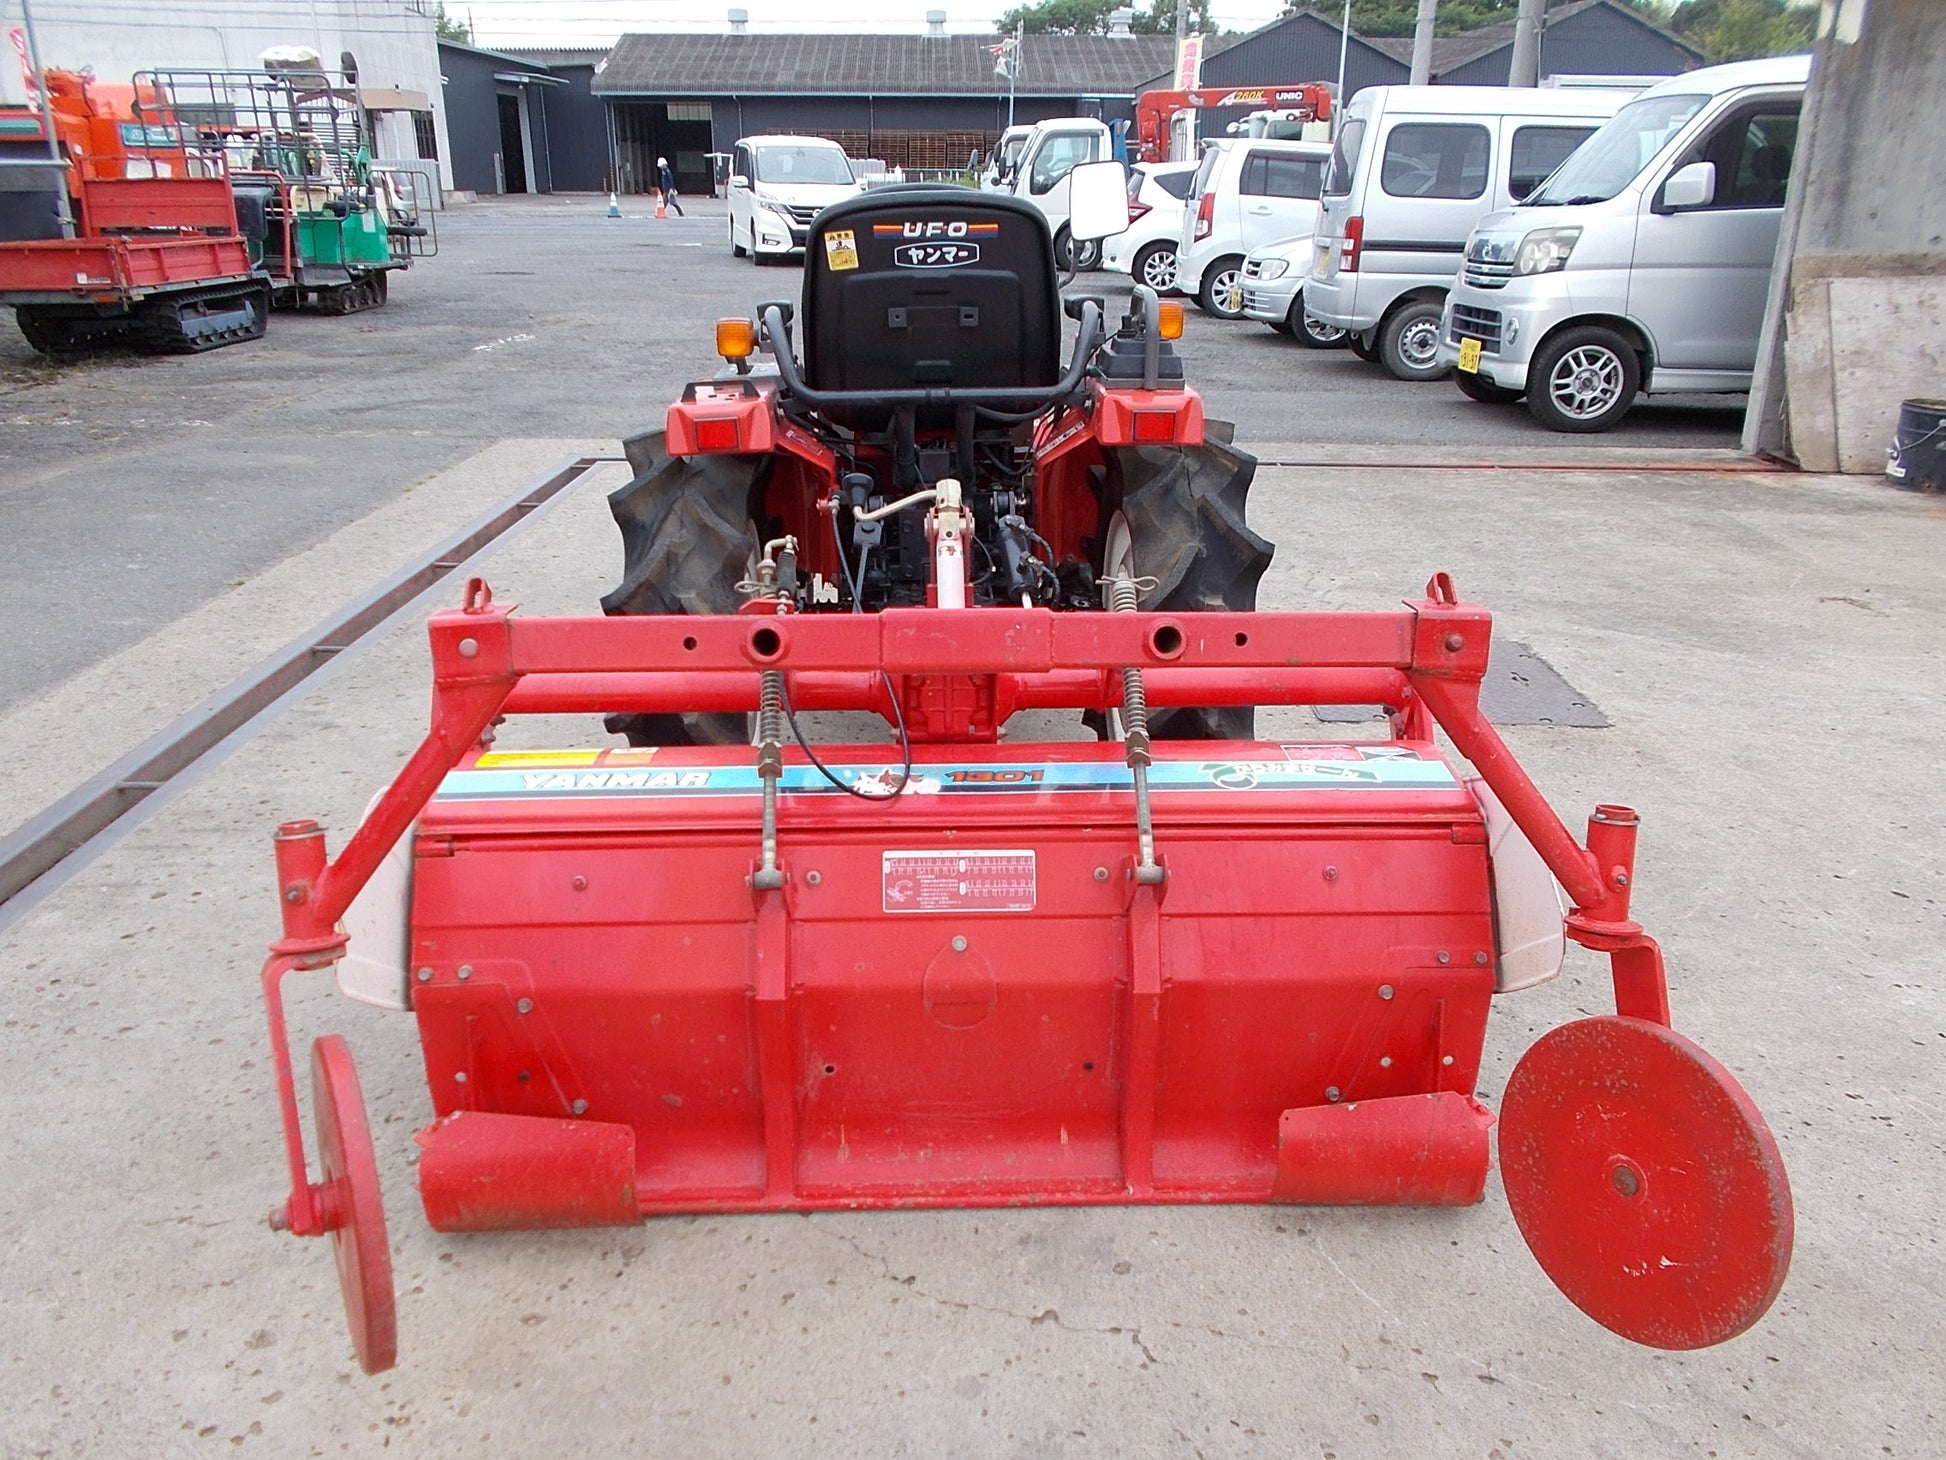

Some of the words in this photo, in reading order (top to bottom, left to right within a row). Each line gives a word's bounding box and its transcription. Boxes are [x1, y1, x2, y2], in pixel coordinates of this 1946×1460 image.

[1275, 91, 1303, 101] UNIC
[902, 221, 968, 238] UFO
[907, 246, 969, 265] ヤンマー
[522, 771, 712, 790] YANMAR
[945, 769, 1045, 783] 1301
